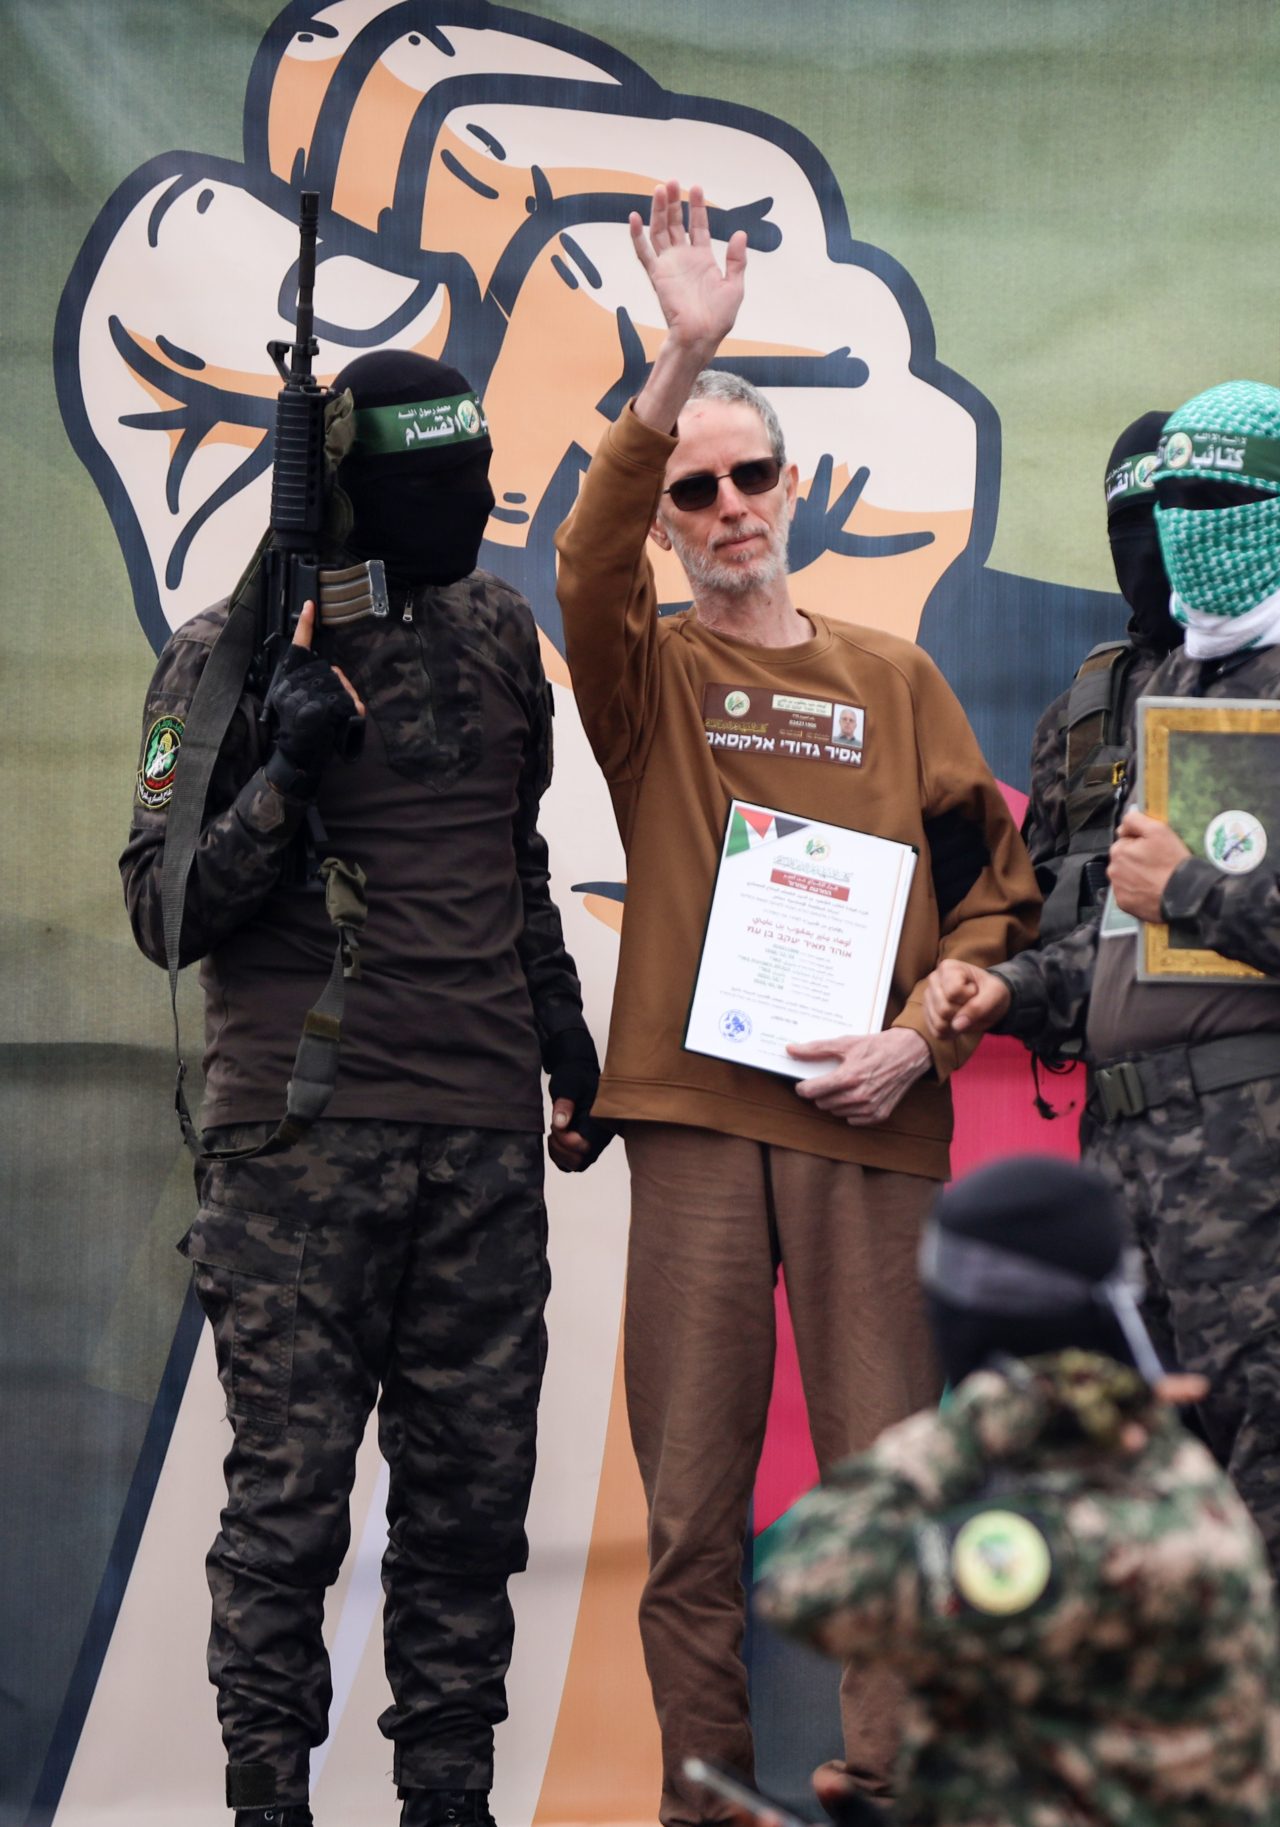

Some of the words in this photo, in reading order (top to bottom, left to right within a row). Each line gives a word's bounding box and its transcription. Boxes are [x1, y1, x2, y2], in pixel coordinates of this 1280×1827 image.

[405, 415, 462, 447] القسام
[1190, 446, 1246, 470] كتائب
[780, 738, 821, 758] גדודי
[824, 745, 862, 764] אסיר
